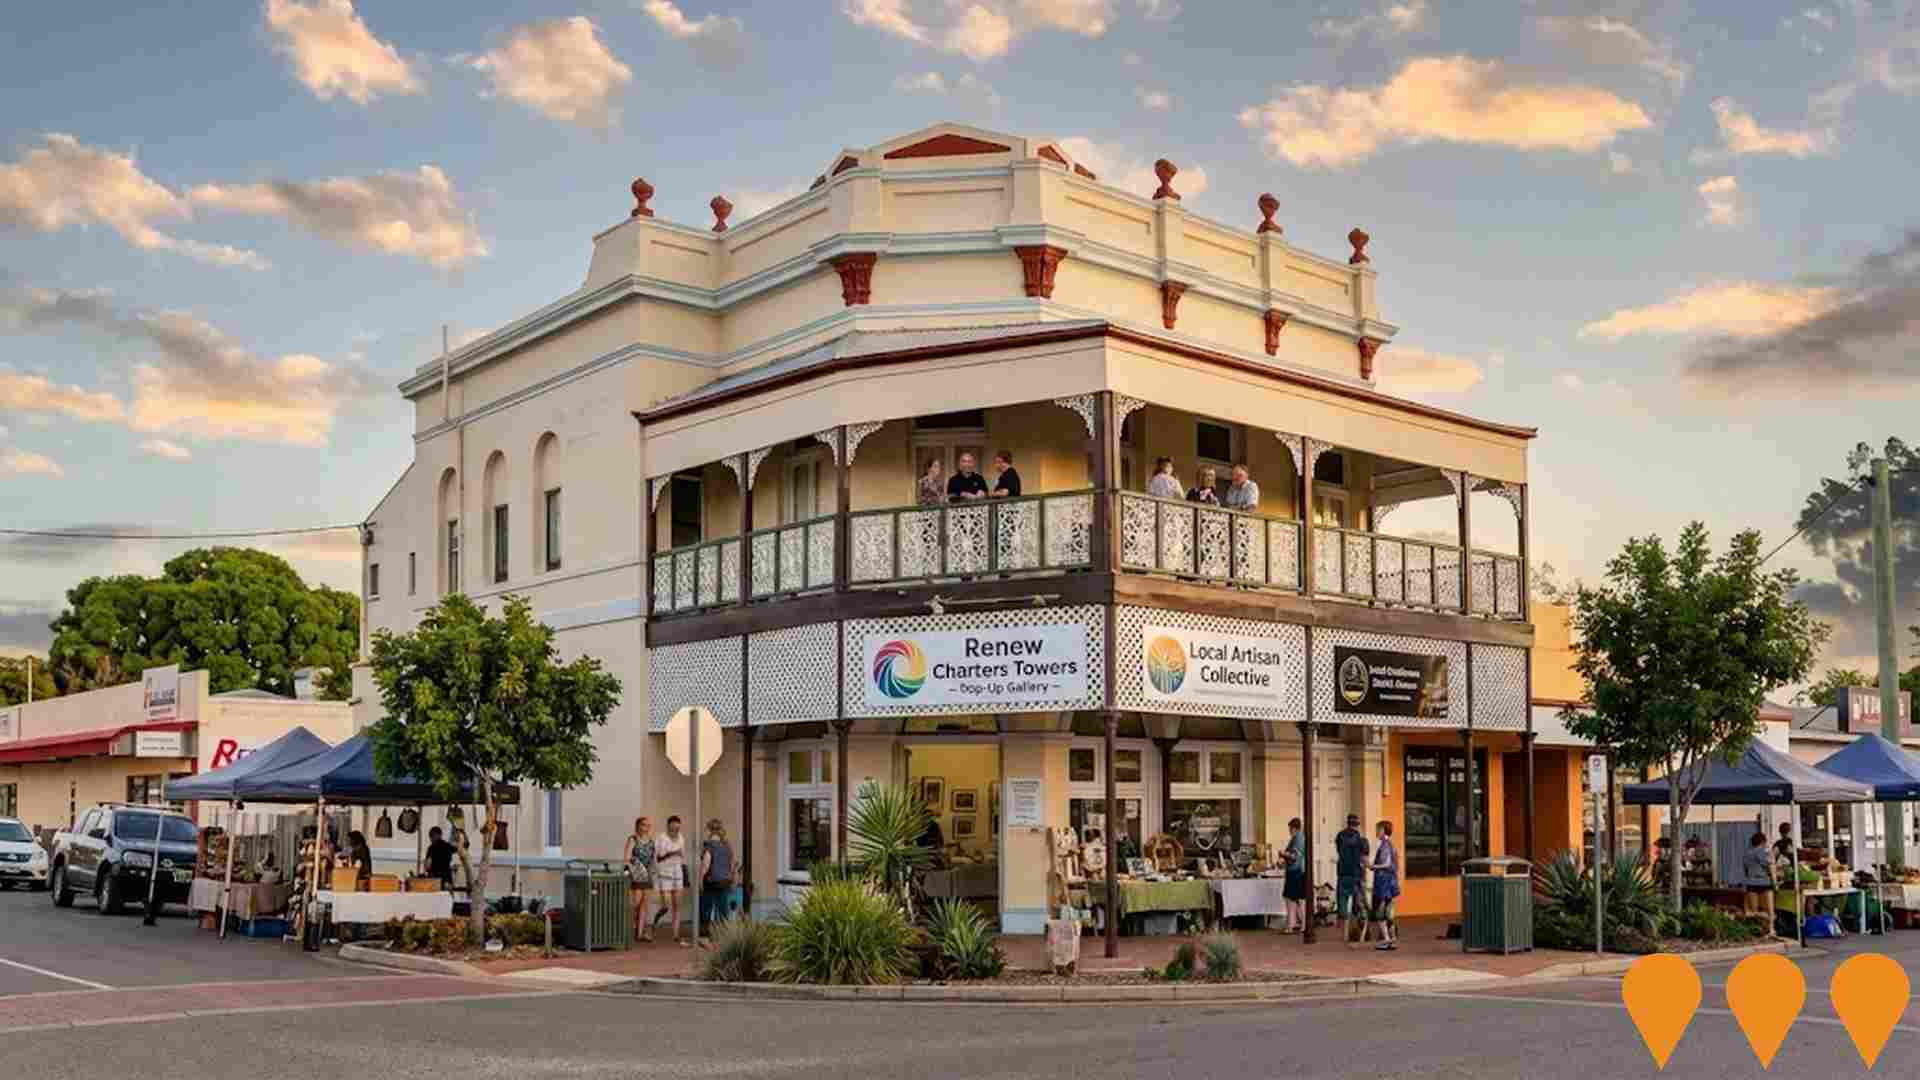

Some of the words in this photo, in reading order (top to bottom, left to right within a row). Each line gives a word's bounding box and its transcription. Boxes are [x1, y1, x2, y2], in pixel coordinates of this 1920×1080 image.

[965, 637, 1044, 657] Renew
[1190, 642, 1227, 661] Local
[1232, 646, 1280, 665] Artisan
[932, 663, 1008, 679] Charters
[1013, 660, 1078, 676] Towers
[1200, 666, 1270, 686] Collective
